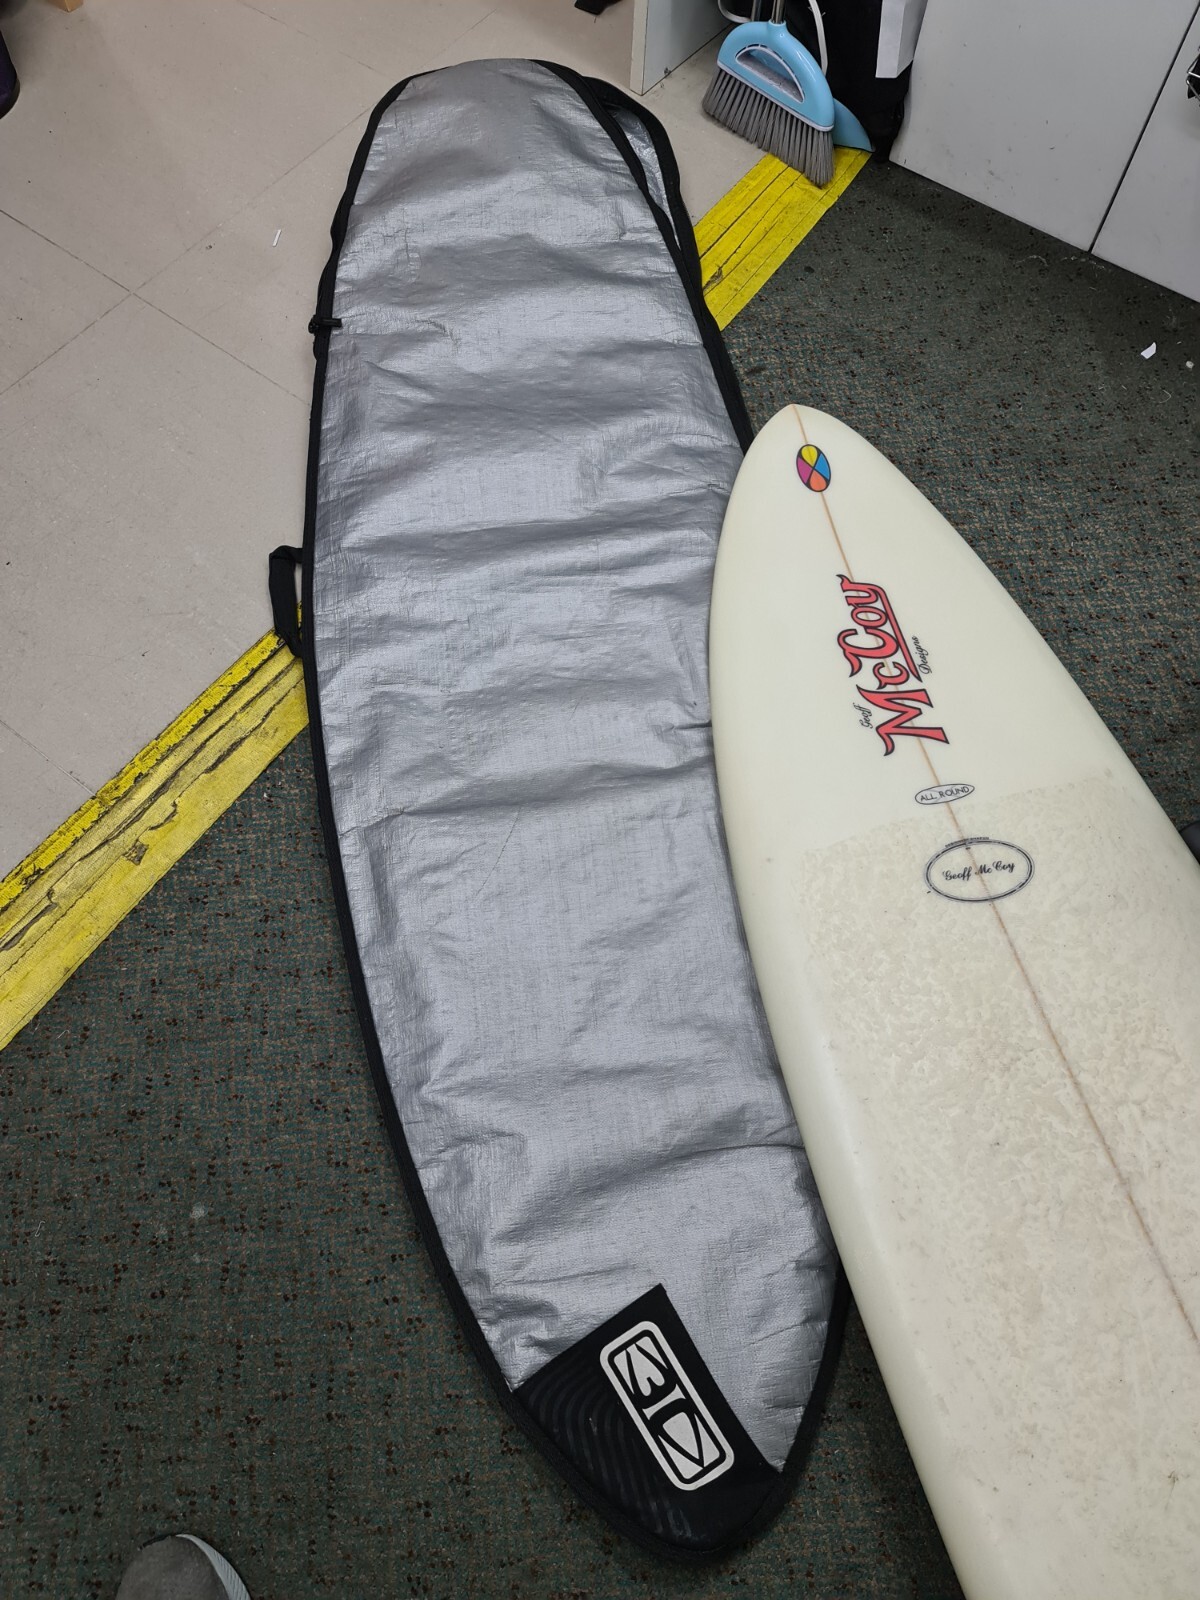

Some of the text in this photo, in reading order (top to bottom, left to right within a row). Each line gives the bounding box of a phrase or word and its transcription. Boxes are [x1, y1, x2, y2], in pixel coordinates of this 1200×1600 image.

[911, 635, 932, 675] Designs
[852, 702, 873, 729] Geoff
[920, 786, 970, 802] ALL ROUND
[942, 866, 973, 881] Geoff
